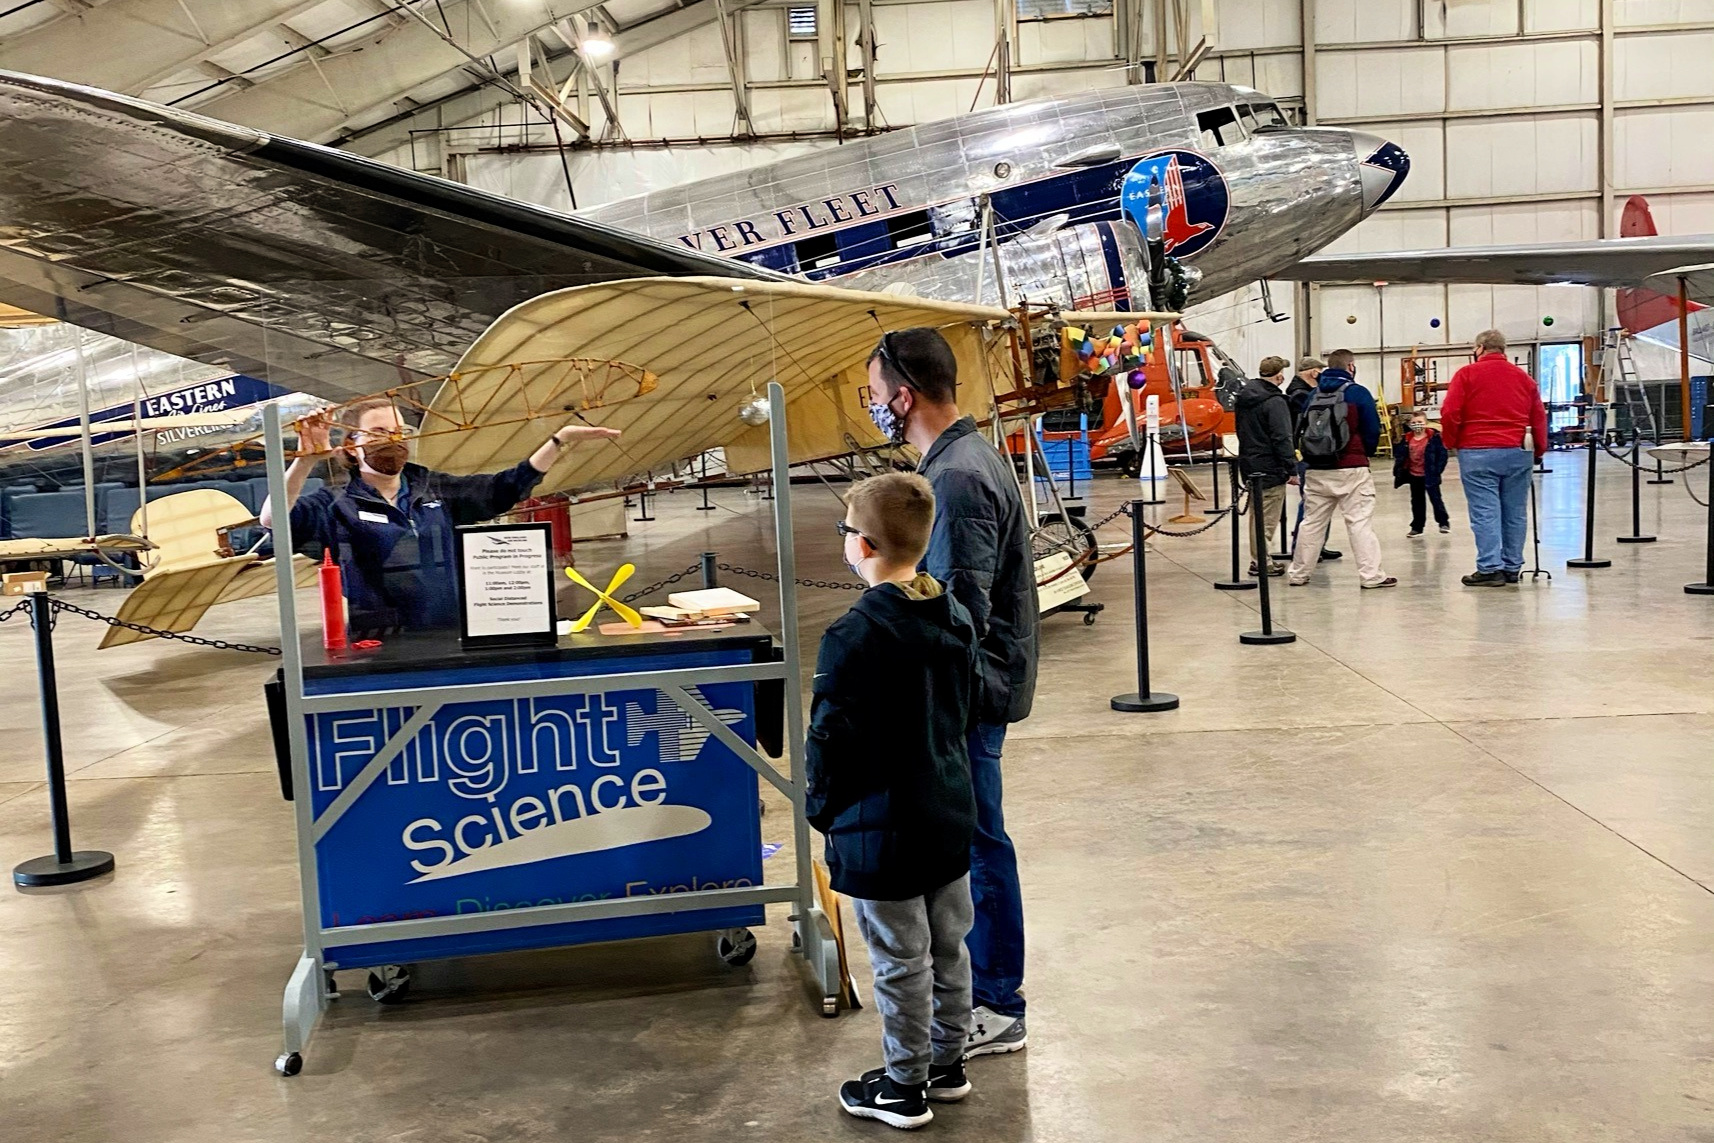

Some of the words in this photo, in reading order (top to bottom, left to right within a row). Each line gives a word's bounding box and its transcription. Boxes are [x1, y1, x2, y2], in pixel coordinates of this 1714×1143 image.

[772, 184, 902, 236] FLEET
[1128, 184, 1180, 201] EASERN
[146, 379, 236, 416] EASTERN
[157, 424, 236, 445] SILVERLIN
[313, 692, 621, 799] Flight
[402, 768, 667, 874] Science
